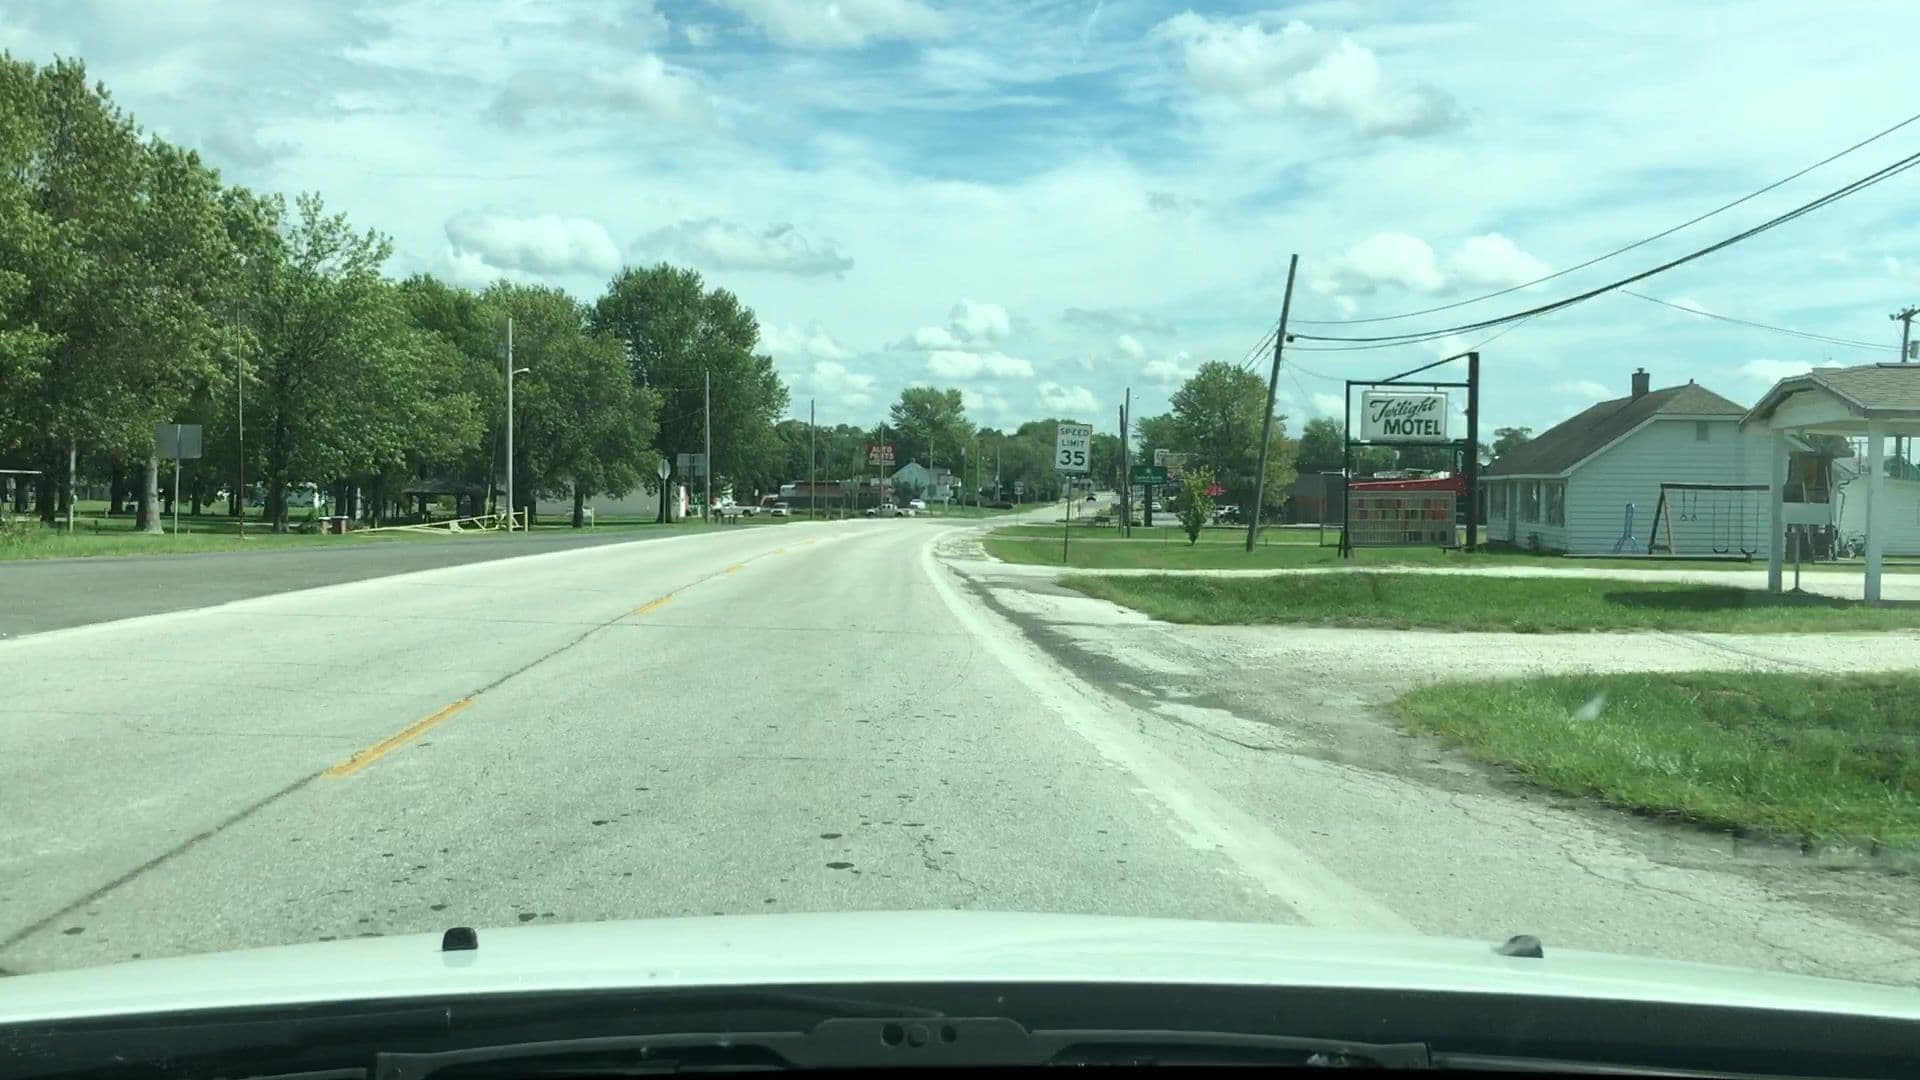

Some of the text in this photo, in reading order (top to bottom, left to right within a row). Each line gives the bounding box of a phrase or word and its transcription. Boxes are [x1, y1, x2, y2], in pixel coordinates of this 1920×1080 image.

[1369, 396, 1437, 423] Twilight
[1060, 427, 1090, 437] SPEED
[1383, 419, 1442, 436] MOTEL
[871, 445, 893, 453] AUTO
[1061, 439, 1085, 448] LIMIT
[1060, 449, 1085, 467] 35
